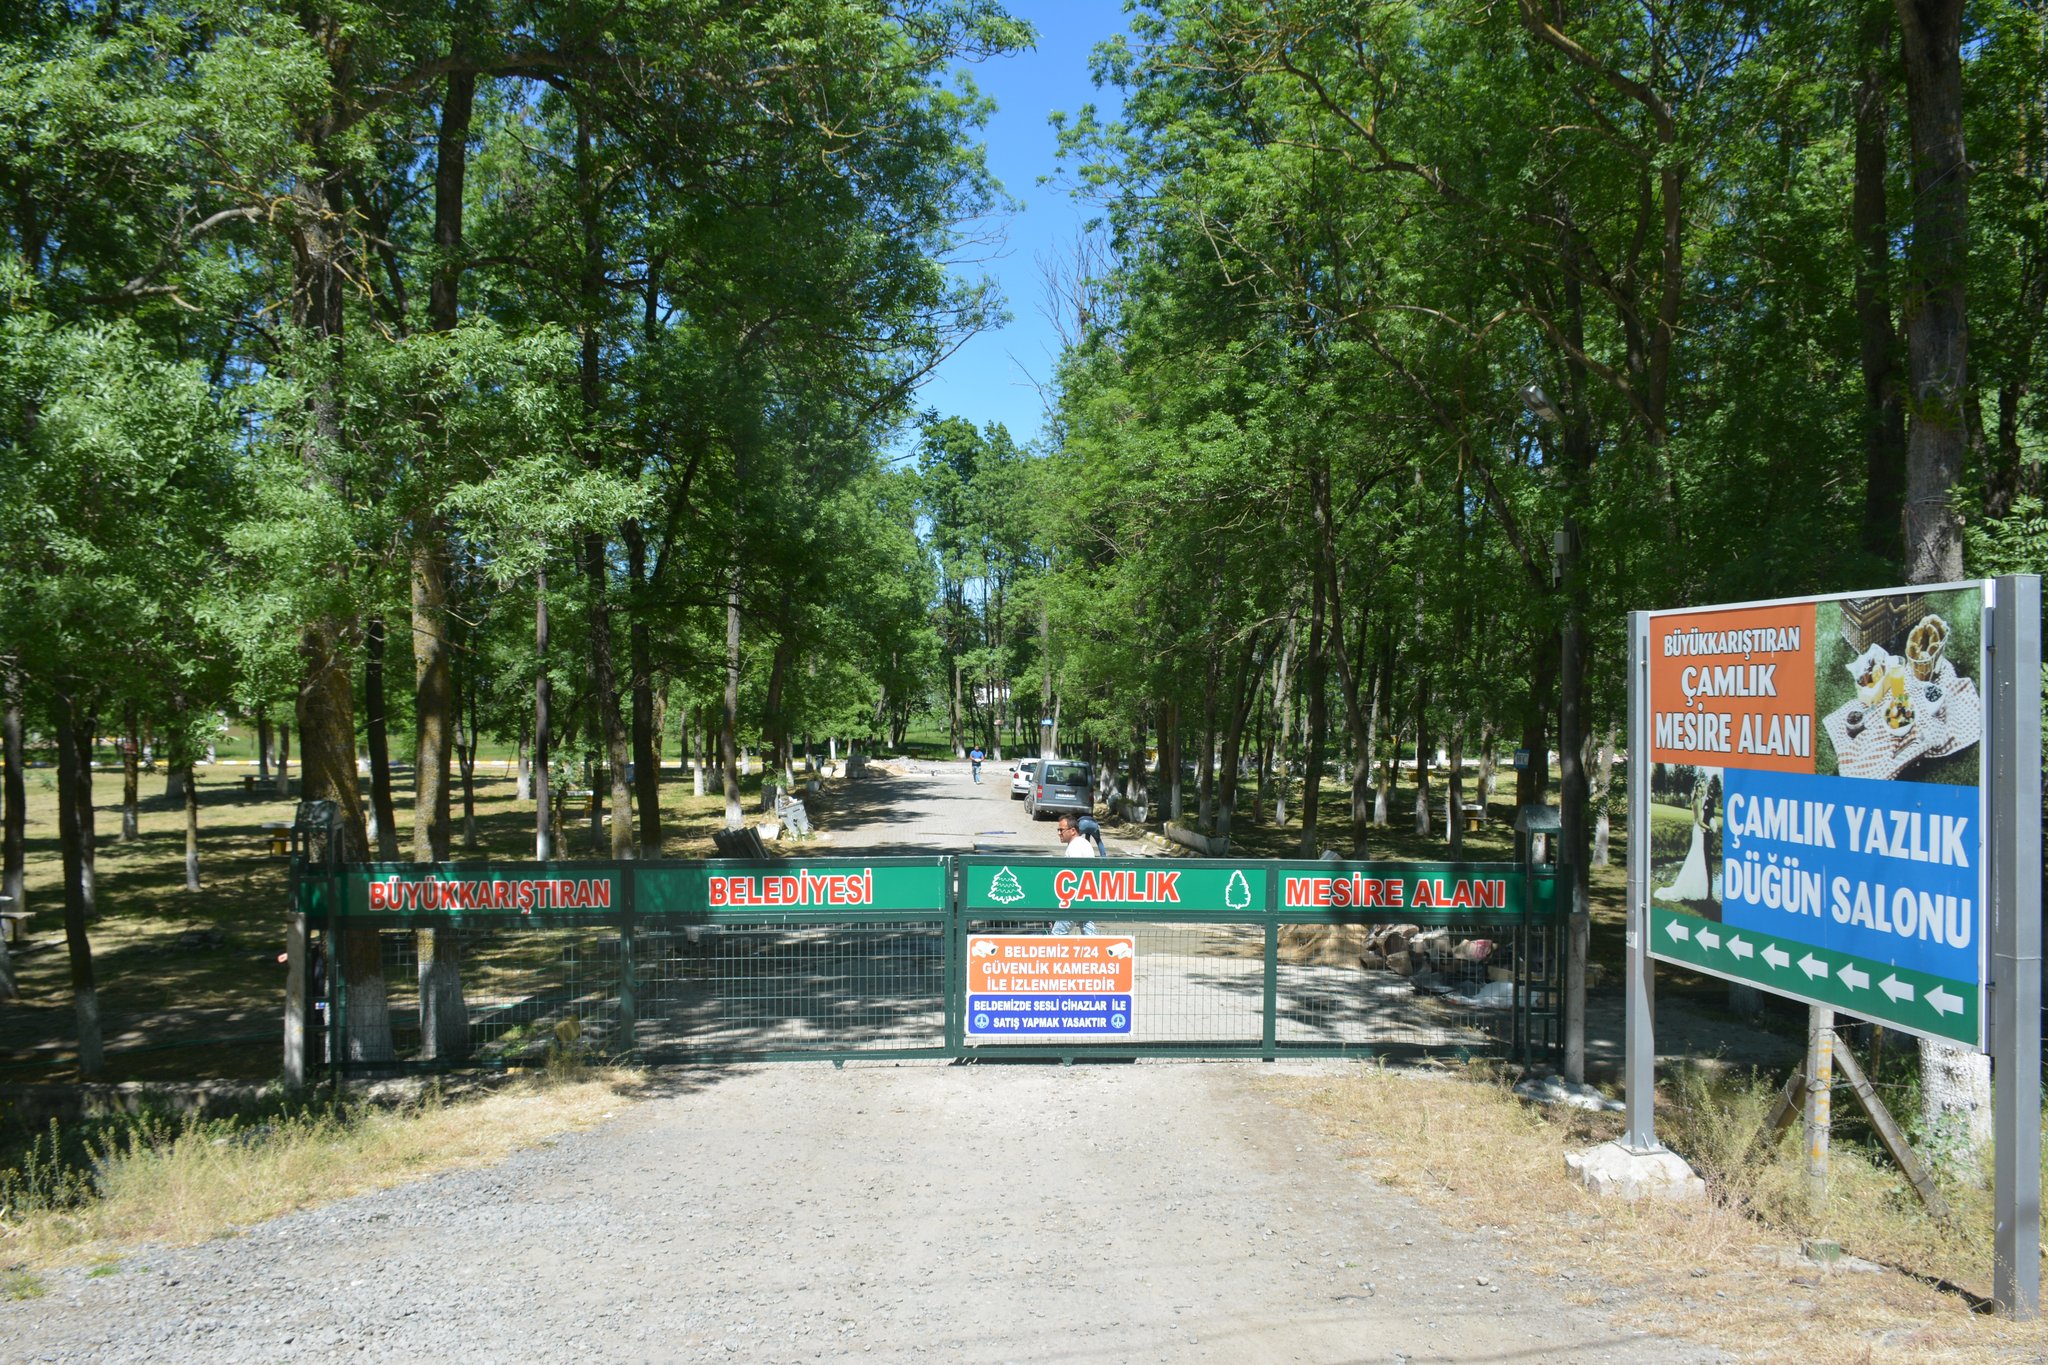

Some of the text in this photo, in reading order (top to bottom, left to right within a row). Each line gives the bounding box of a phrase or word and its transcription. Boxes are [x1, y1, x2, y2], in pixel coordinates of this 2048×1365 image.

[1664, 625, 1800, 660] BÜYÜKKARIŞTIRAN
[1681, 664, 1777, 706] ÇAMLIK
[1656, 700, 1811, 758] MESİRE ALANI
[1727, 792, 1969, 868] ÇAMLIK YAZLIK
[369, 875, 611, 914] BÜYÜKKARIŞTIRAN
[709, 868, 873, 906] BELEDİYESİ
[1054, 869, 1181, 908] ÇAMLIK
[1285, 872, 1506, 908] MESİRE ALANI
[1725, 851, 1971, 949] DÜĞÜN SALONU
[982, 960, 1120, 975] GÜVENLİK KAMERASI
[1004, 943, 1099, 958] BELDEMİZ 7/24
[987, 977, 1115, 991] İLE İZLENMEKTEDİR
[974, 998, 1127, 1011] BELDEMİZDE SESLİ CİHAZLAR İLE
[993, 1017, 1107, 1030] SATIŞ YAPMAK YASAKTIR
